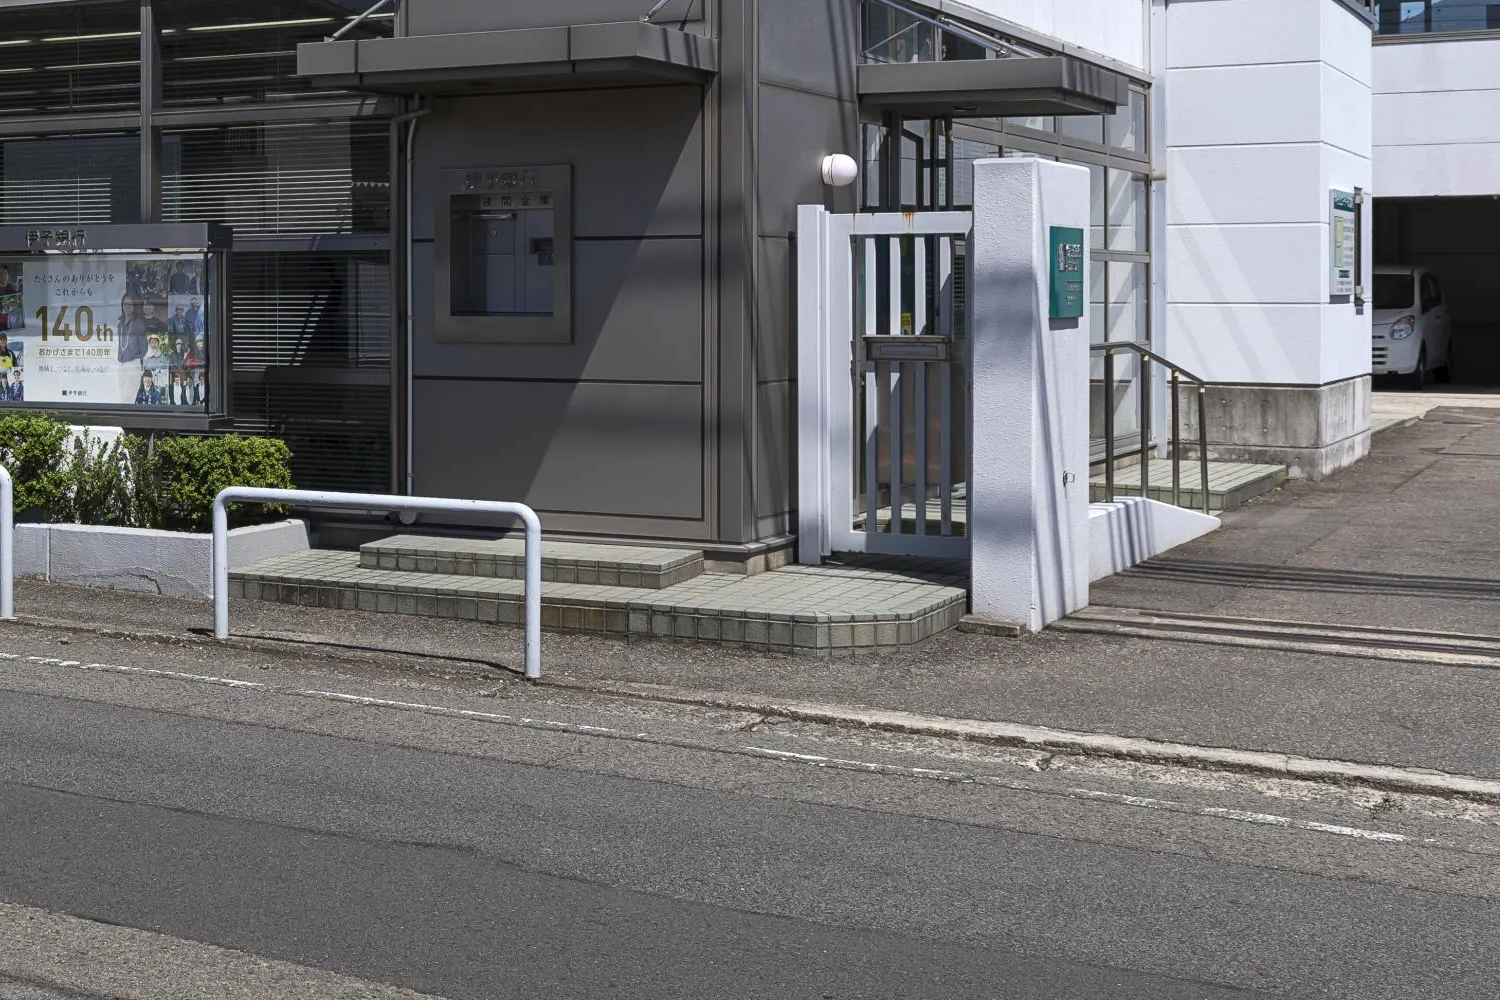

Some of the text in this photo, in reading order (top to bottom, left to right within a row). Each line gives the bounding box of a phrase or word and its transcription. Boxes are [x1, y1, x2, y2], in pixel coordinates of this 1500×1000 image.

[26, 229, 86, 248] 伊予銀行
[34, 274, 115, 284] たくさんのありがとうを
[55, 288, 93, 296] これからも
[38, 347, 111, 357] おかげさまで140周年
